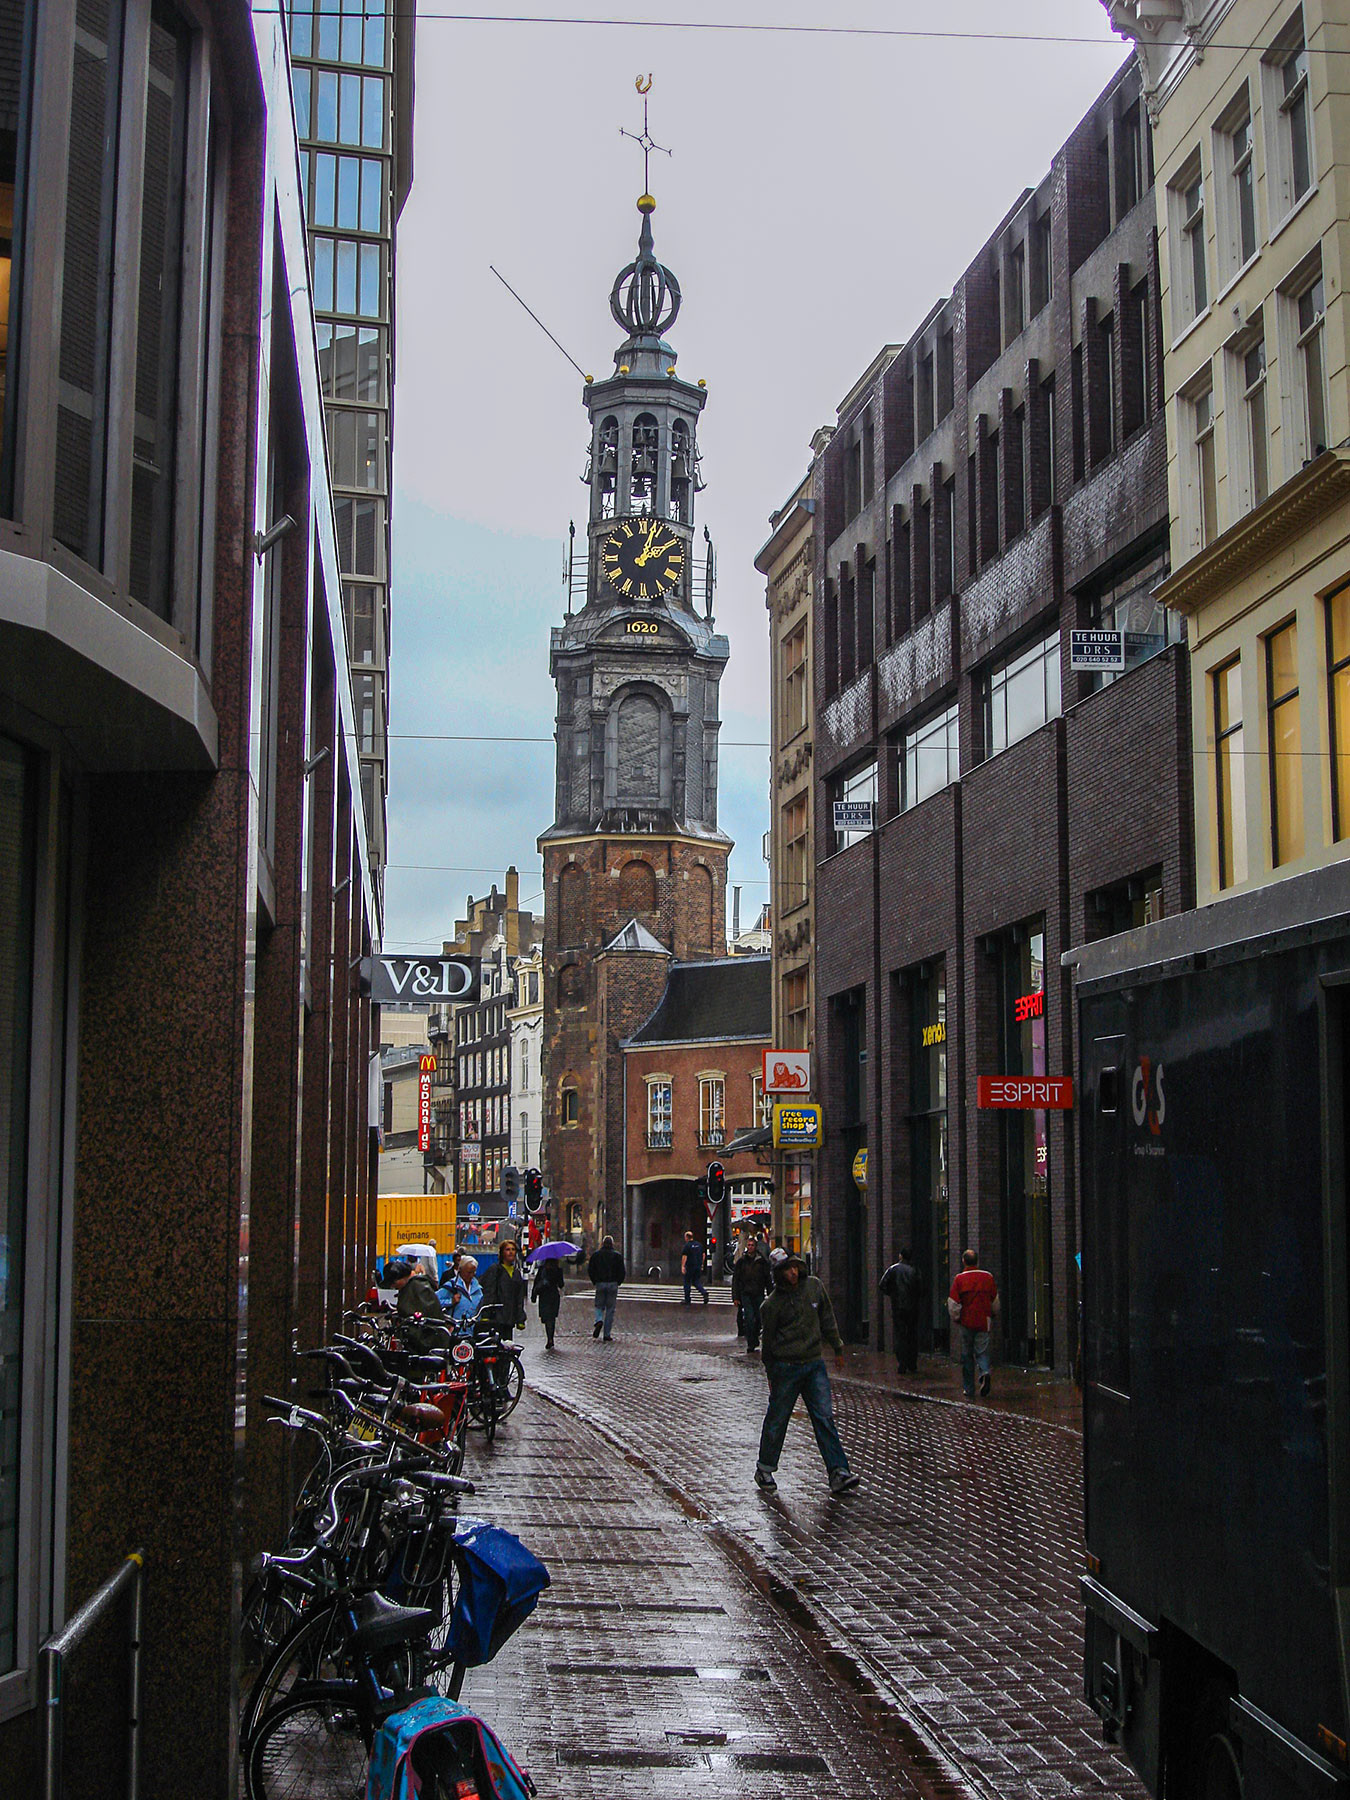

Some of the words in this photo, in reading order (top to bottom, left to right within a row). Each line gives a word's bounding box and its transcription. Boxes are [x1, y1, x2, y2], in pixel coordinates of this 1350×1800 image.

[626, 621, 658, 634] 1620
[1075, 633, 1087, 641] TE
[1090, 633, 1118, 642] HUUR
[379, 960, 473, 996] V&D
[1015, 990, 1045, 1022] ESPRIT
[990, 1082, 1064, 1103] ESPRIT
[781, 1122, 805, 1130] shop
